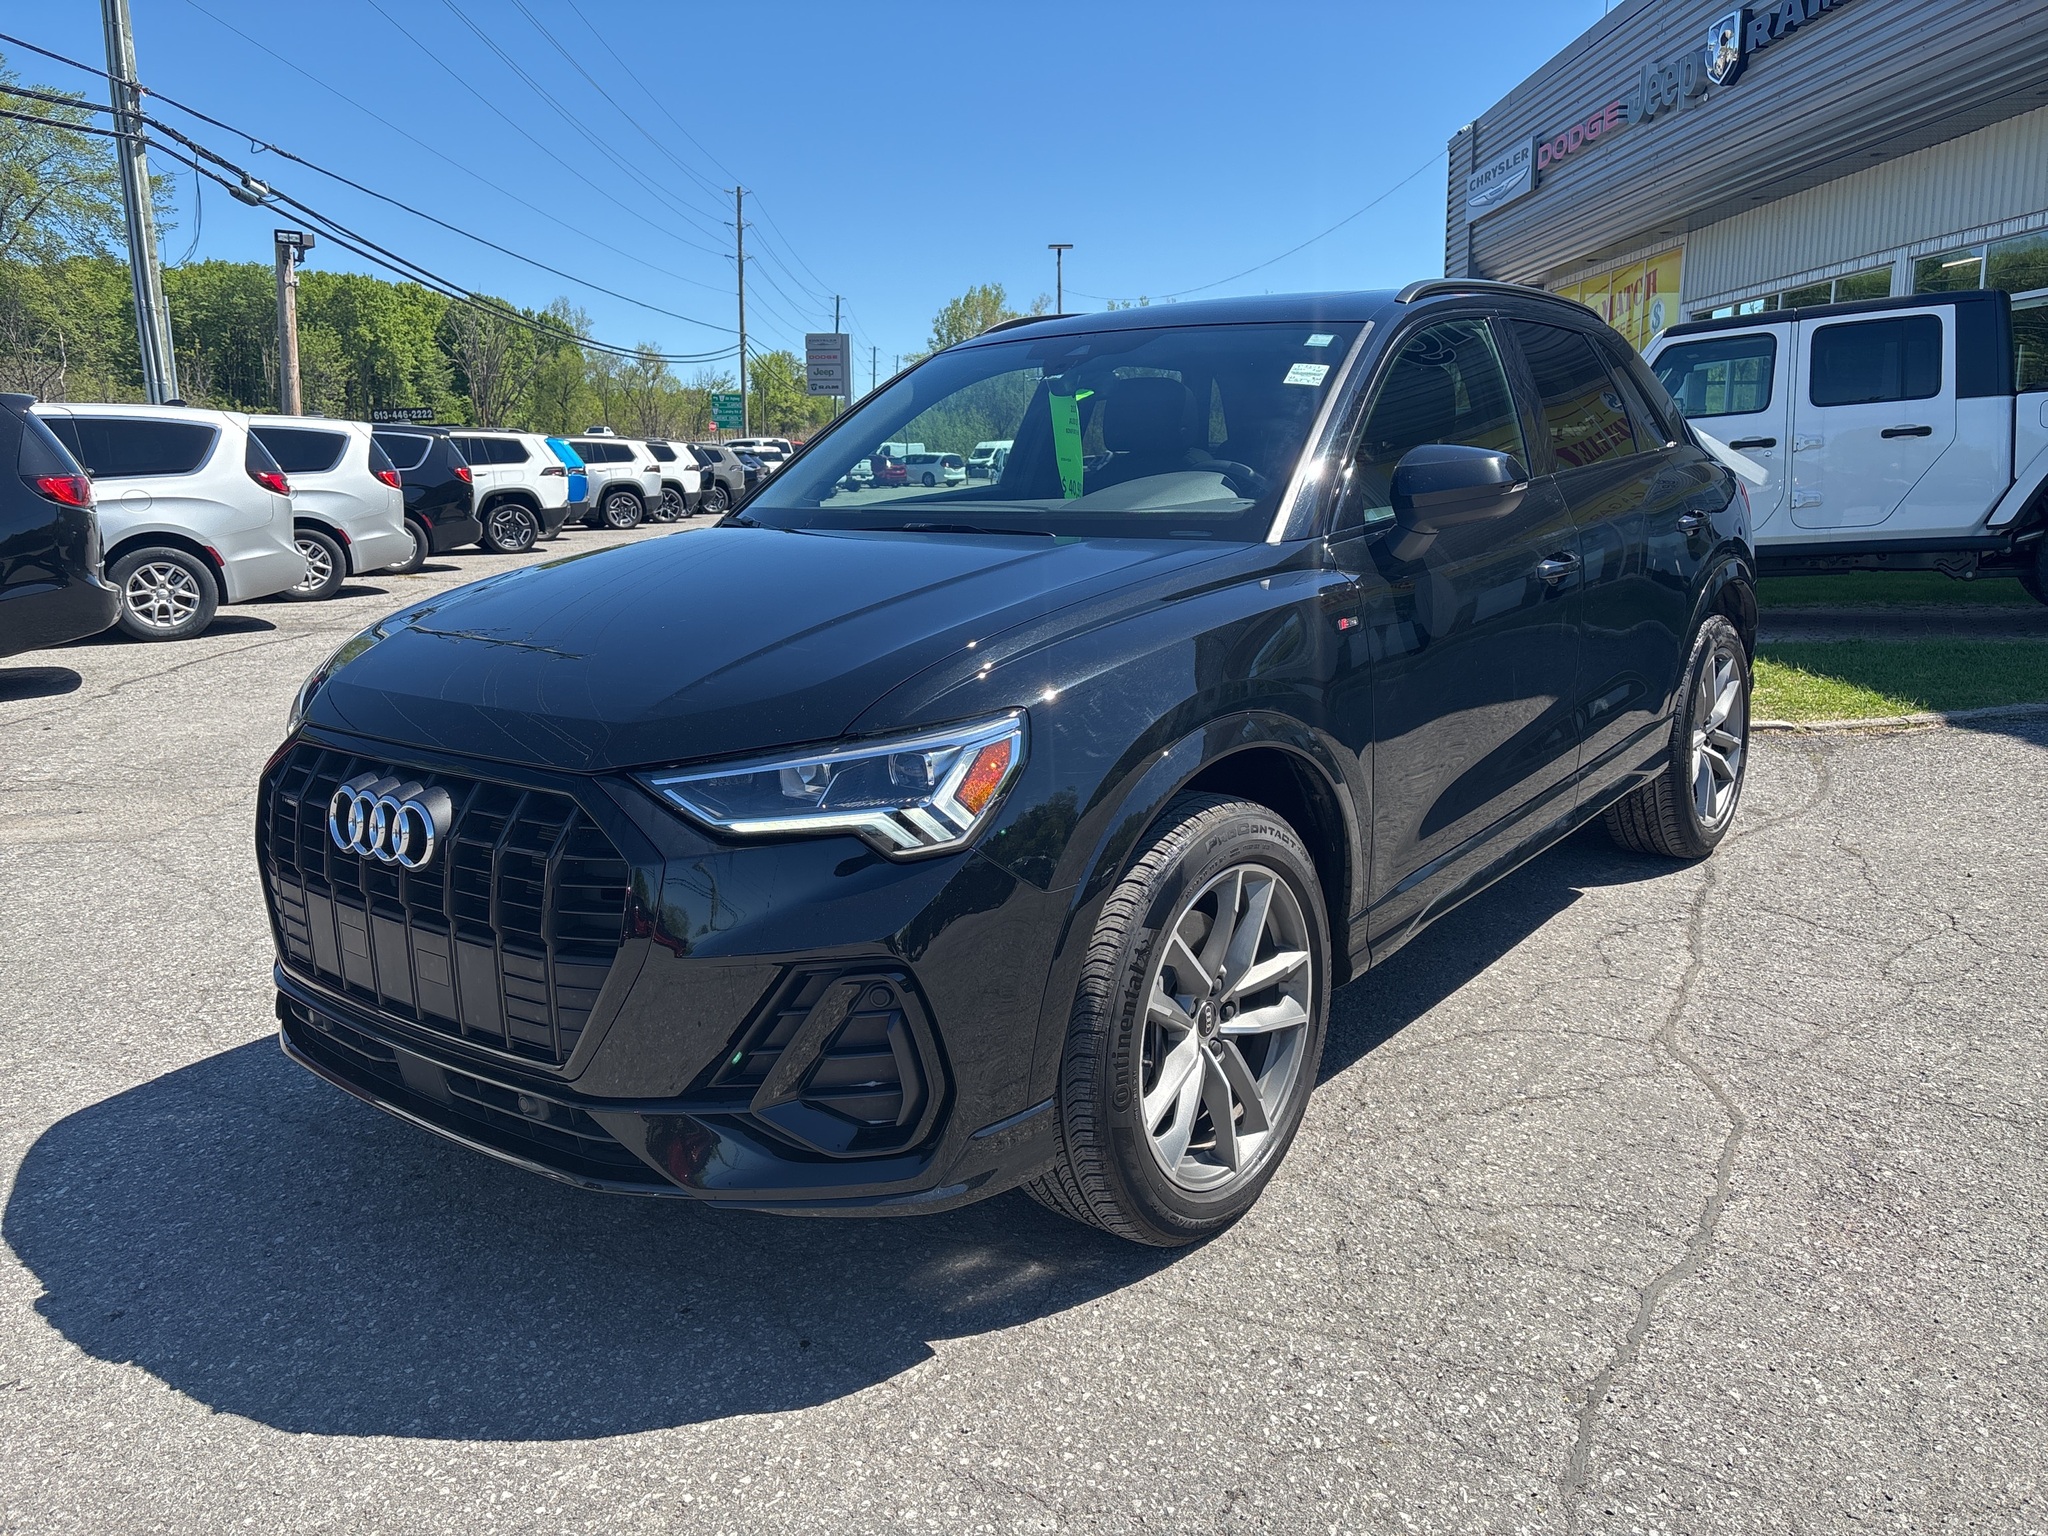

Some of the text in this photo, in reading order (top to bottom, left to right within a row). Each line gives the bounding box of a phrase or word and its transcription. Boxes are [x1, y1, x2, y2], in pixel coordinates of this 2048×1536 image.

[1745, 0, 1831, 54] RA
[1627, 51, 1698, 126] Jeep
[1537, 100, 1621, 170] DODGE
[1469, 146, 1530, 192] CHRYSLER
[813, 367, 835, 377] Jeep
[1111, 963, 1147, 1113] Continental
